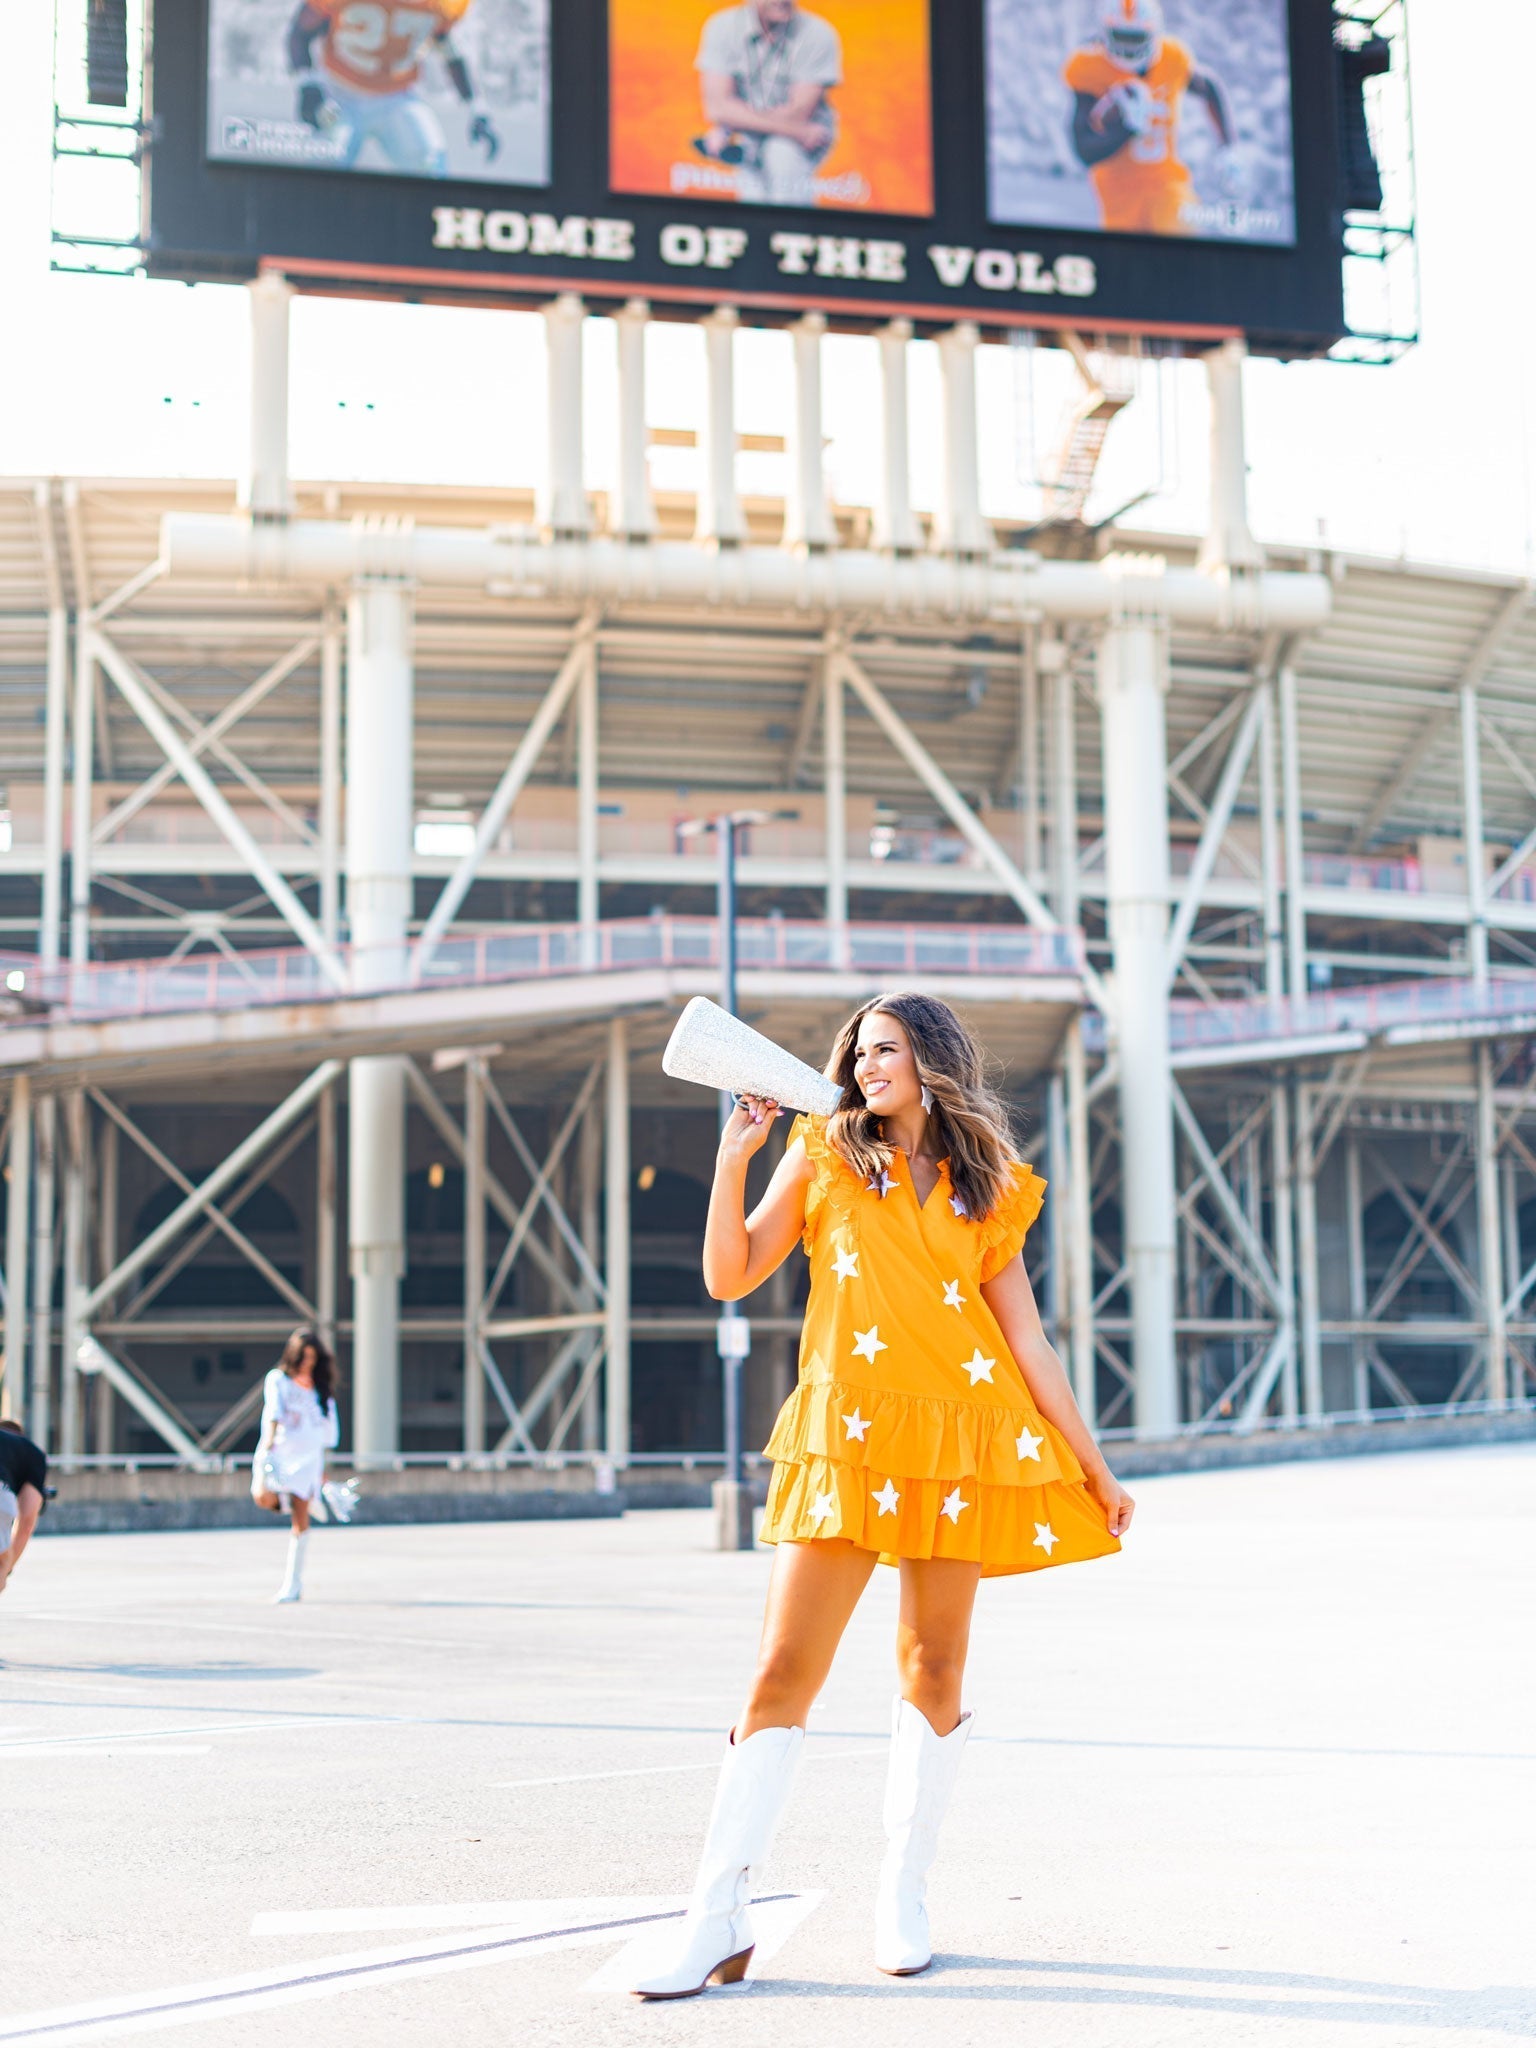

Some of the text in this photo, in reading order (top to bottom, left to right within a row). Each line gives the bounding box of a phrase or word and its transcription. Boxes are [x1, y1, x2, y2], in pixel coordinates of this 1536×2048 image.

[334, 3, 436, 74] 27
[432, 206, 1096, 296] HOME OF THE VOLS
